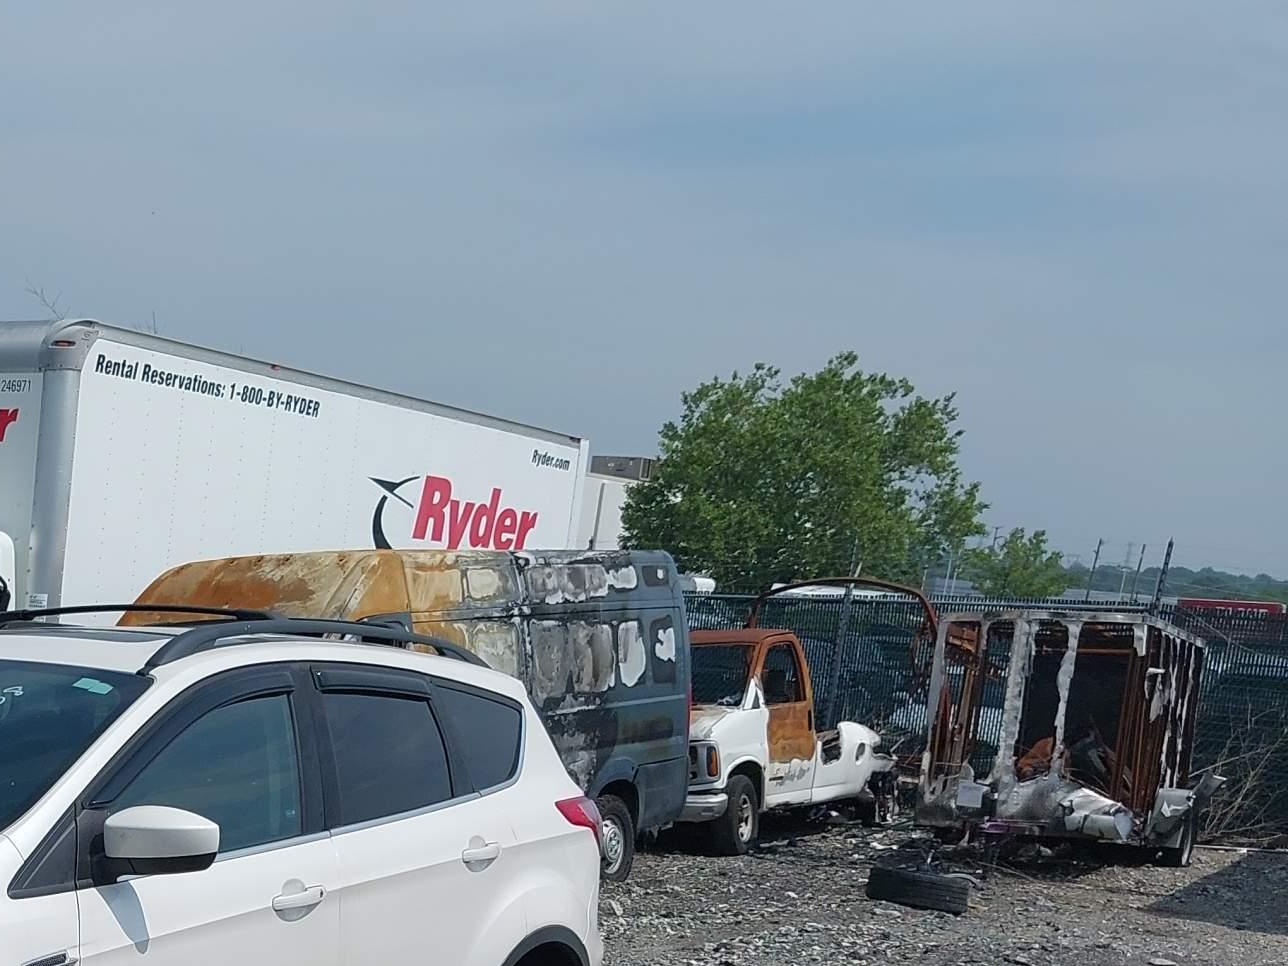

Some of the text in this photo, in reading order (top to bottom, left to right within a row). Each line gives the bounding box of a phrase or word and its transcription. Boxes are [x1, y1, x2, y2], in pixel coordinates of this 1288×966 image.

[0, 379, 32, 393] 246971
[94, 354, 321, 418] Rental Reservations: 1-800-BY-RYDER
[531, 449, 570, 471] Ryder.com
[412, 475, 539, 550] Ryder
